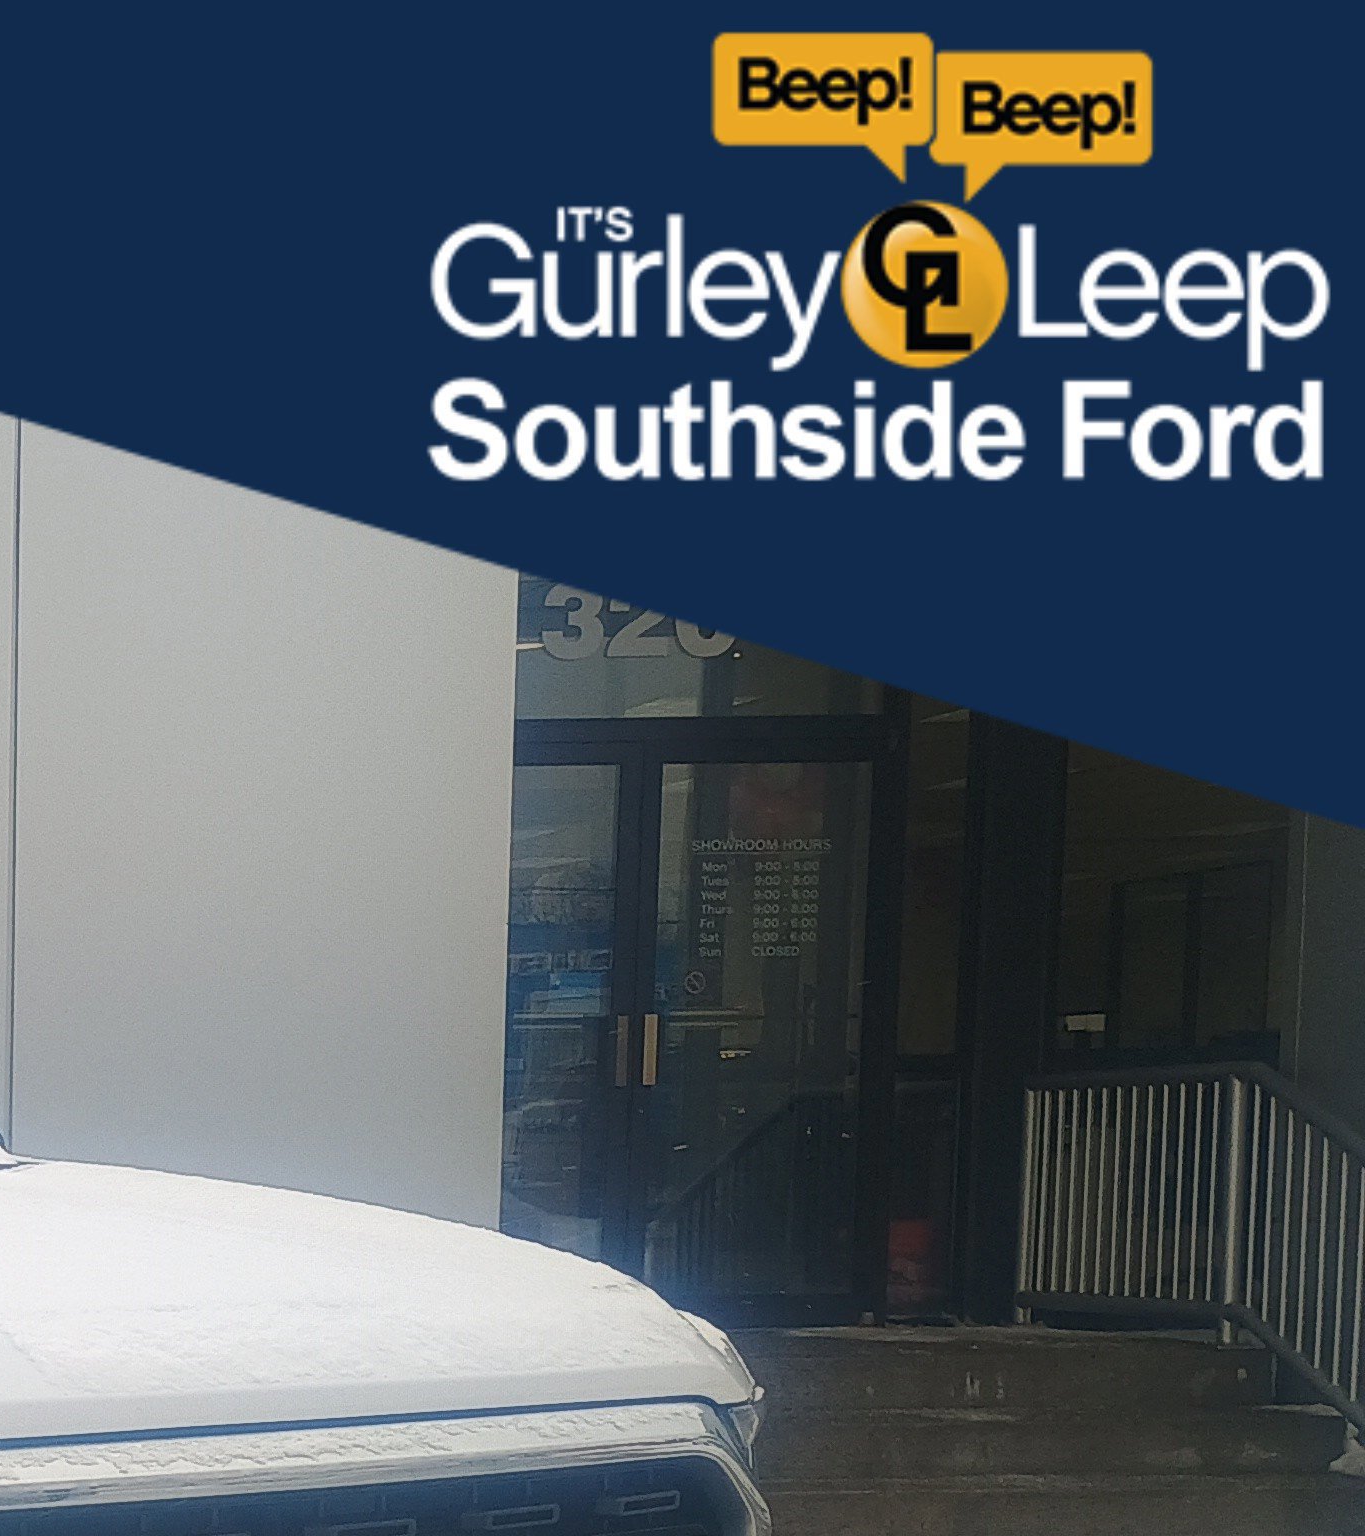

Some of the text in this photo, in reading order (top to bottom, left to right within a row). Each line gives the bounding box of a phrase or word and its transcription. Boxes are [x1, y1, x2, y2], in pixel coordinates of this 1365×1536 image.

[692, 838, 832, 851] SHOWROOM HOURS
[751, 946, 799, 957] CLOSED
